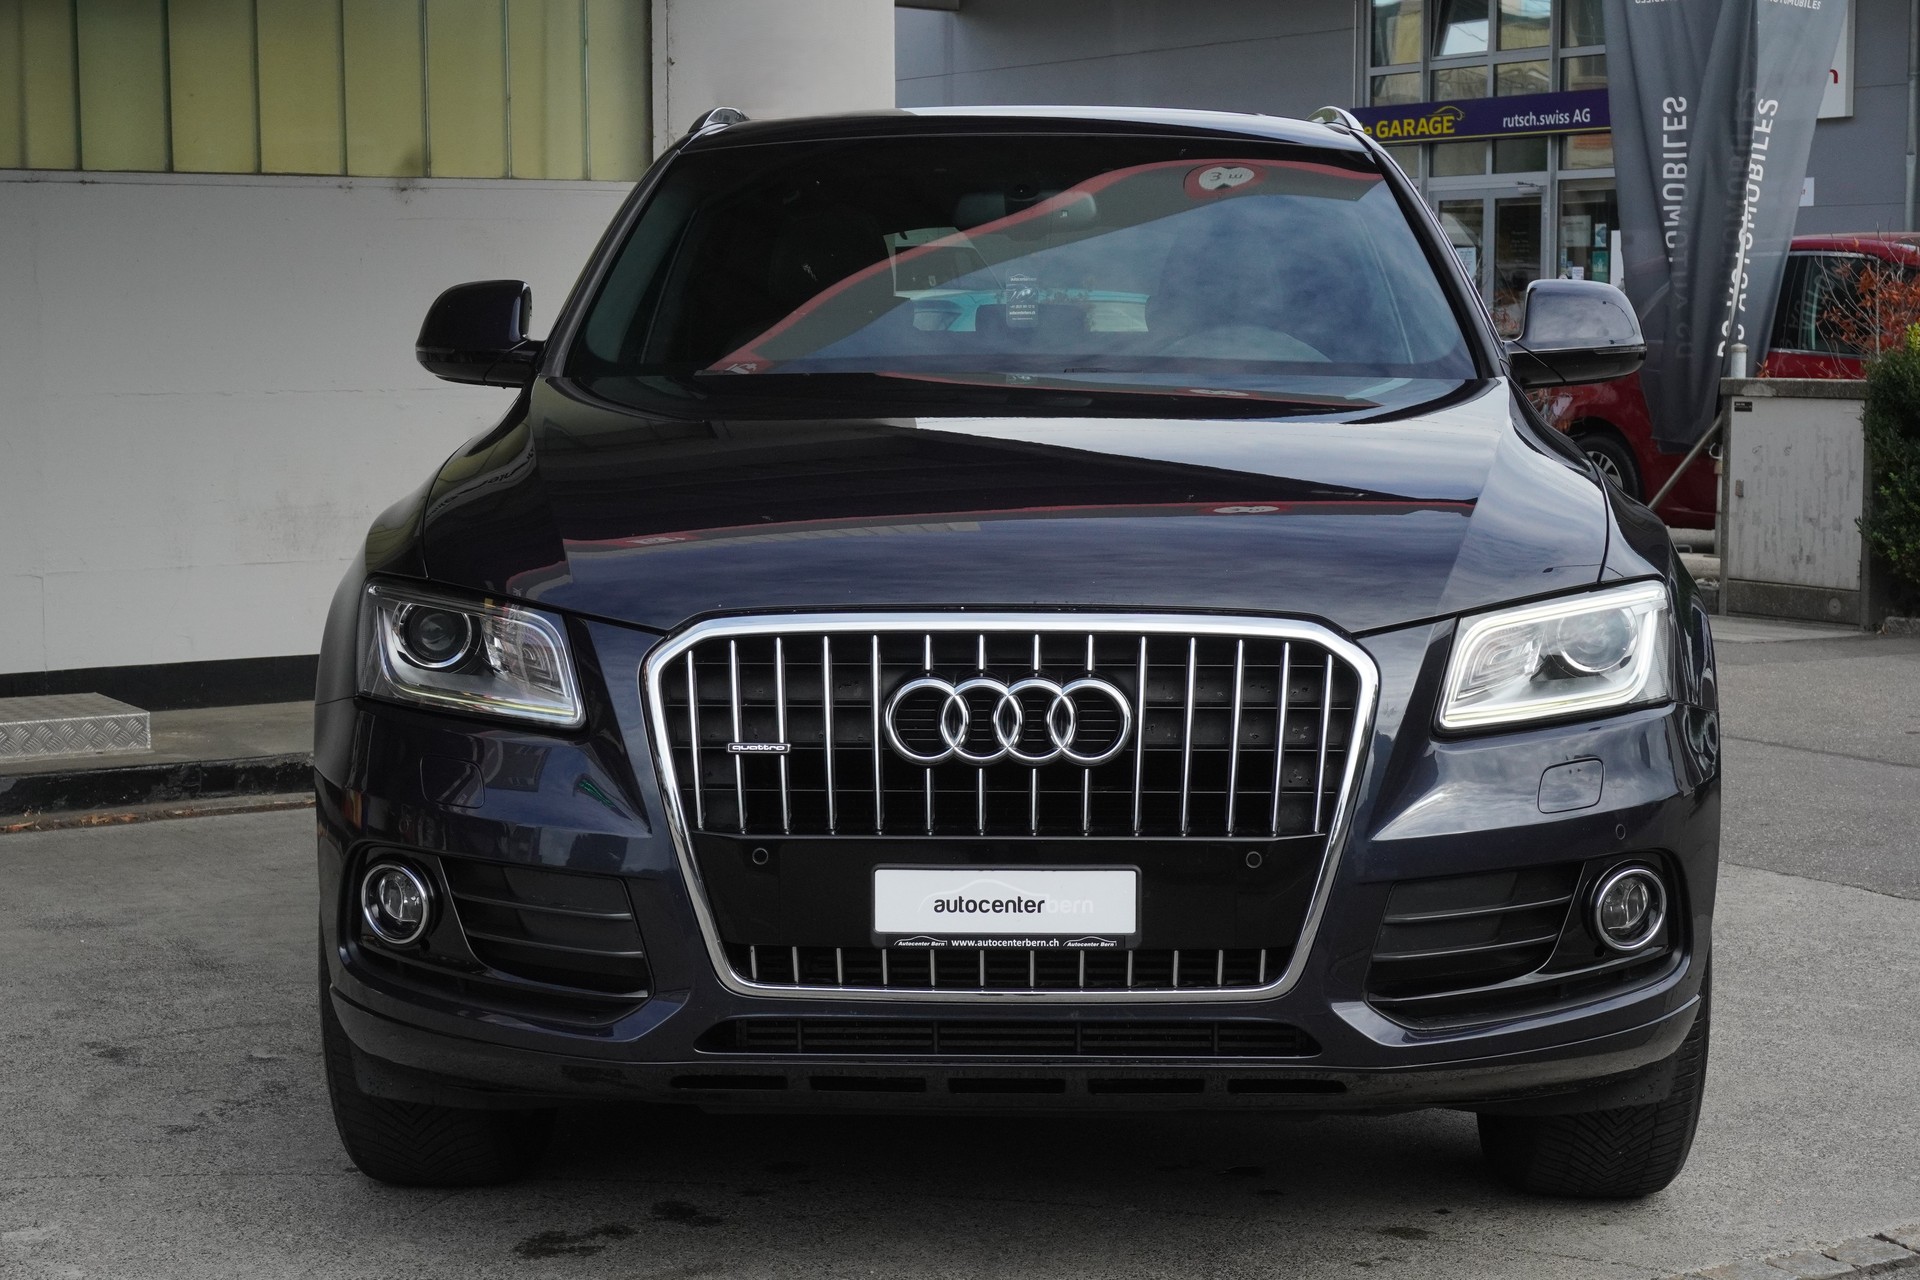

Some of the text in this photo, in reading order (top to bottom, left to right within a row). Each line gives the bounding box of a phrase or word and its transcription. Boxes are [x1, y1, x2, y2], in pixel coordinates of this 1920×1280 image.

[1769, 0, 1822, 10] MOBILES
[1362, 115, 1455, 139] e GARAGE
[1503, 108, 1591, 128] rutsch.swiss AG
[1733, 98, 1779, 313] OBILES
[951, 938, 1060, 947] www.autocenterbern.ch
